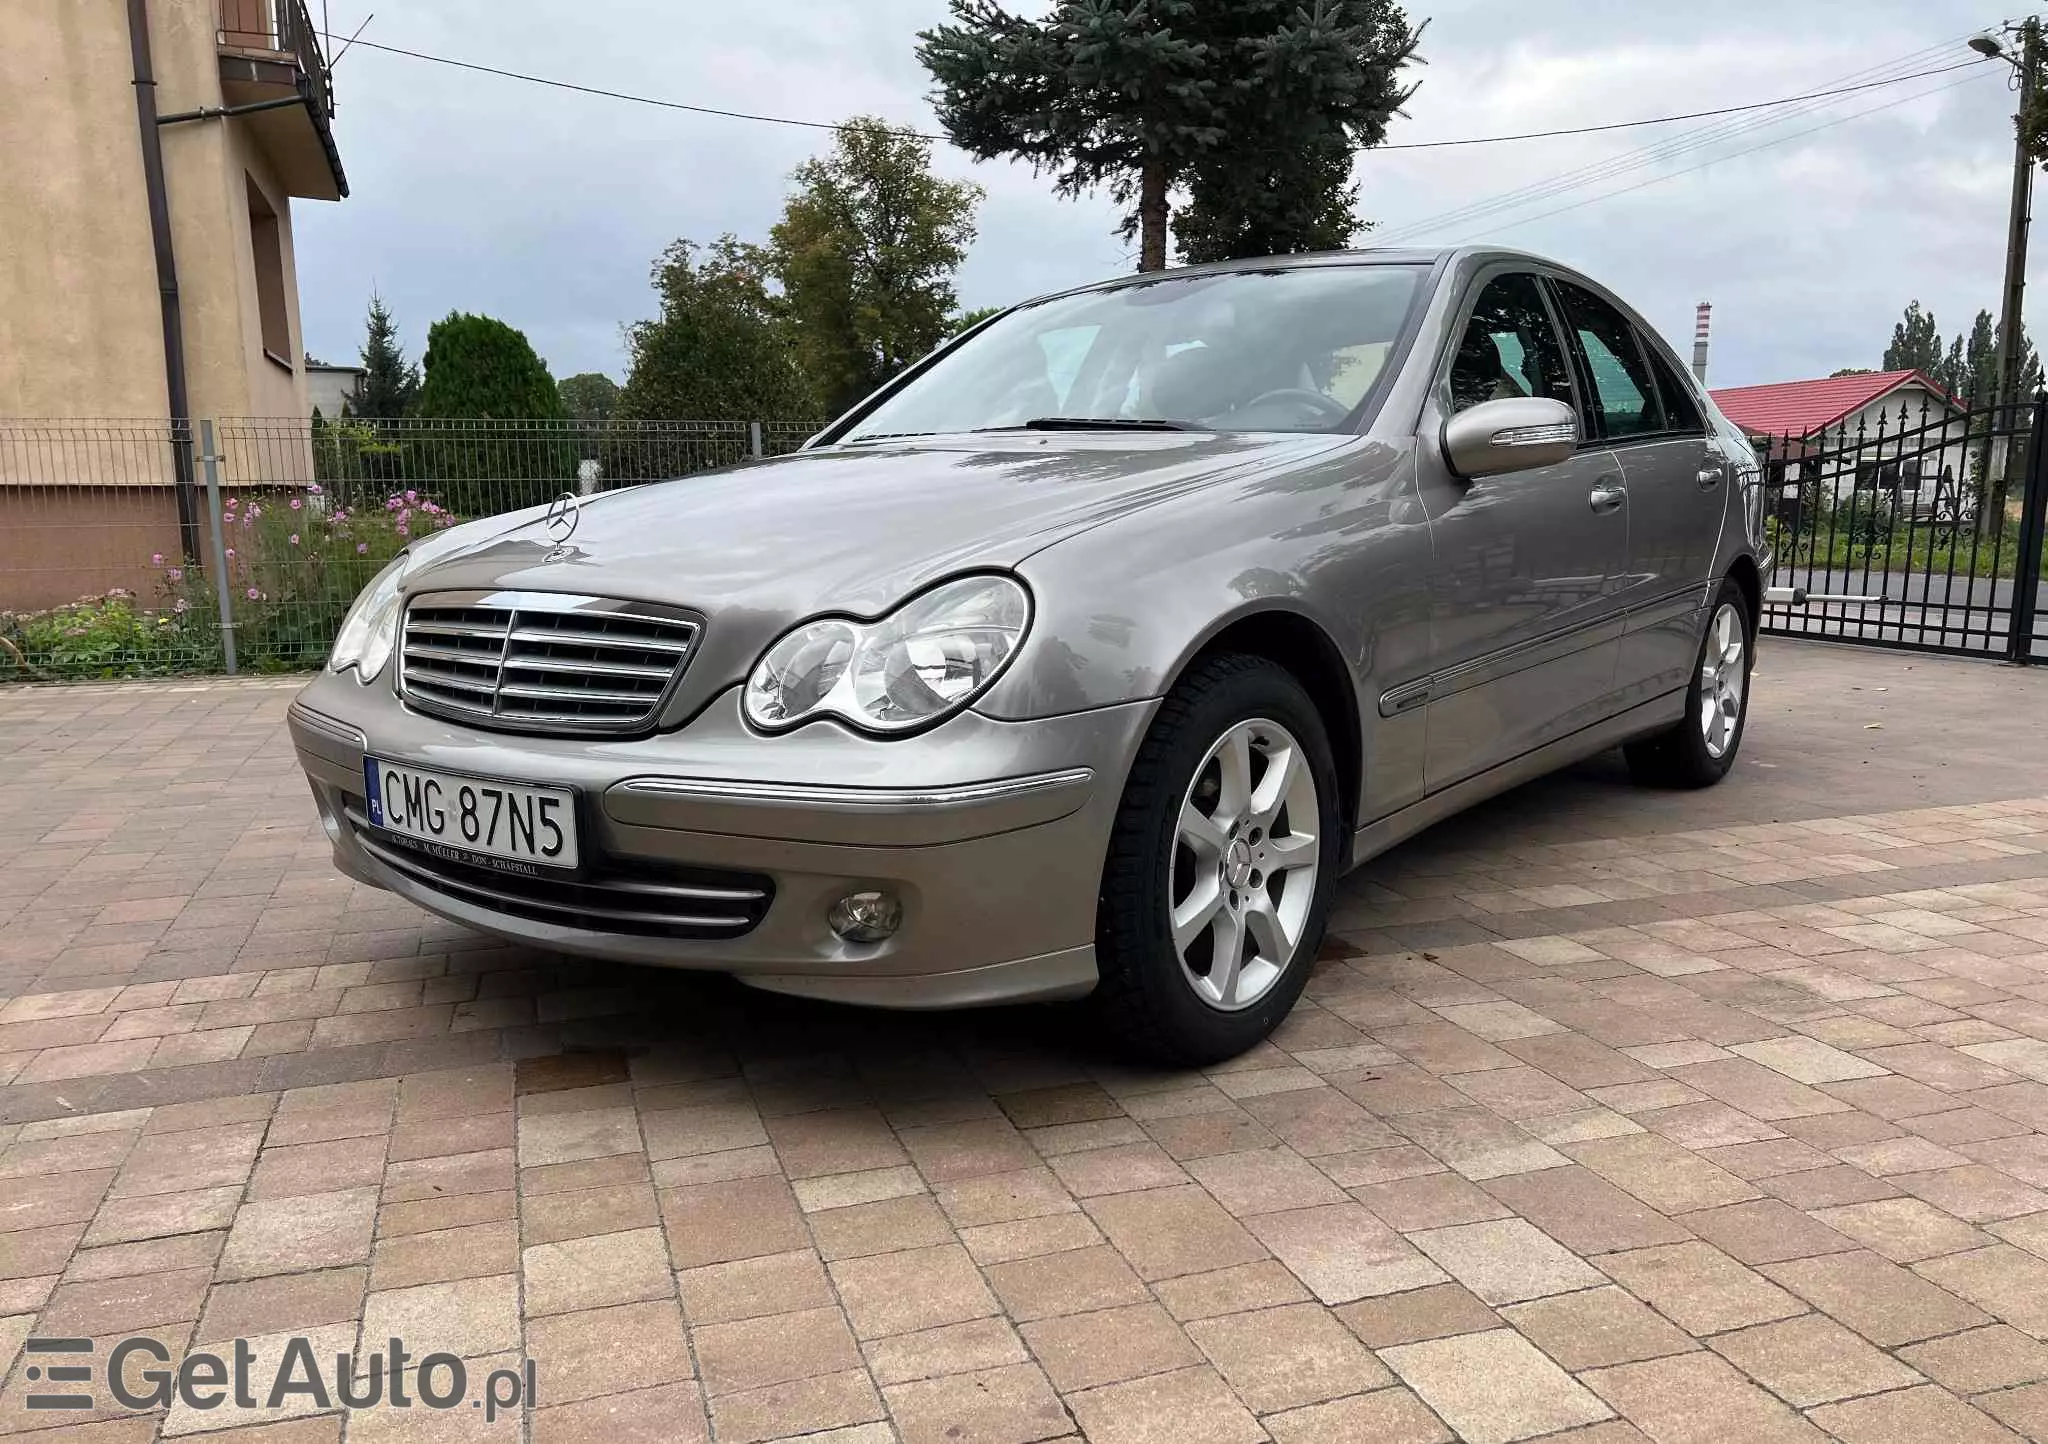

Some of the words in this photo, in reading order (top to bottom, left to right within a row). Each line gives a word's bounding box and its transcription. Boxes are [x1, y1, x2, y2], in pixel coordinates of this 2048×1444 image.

[371, 799, 382, 814] PL
[385, 769, 445, 835] CMG
[459, 785, 564, 857] 87N5
